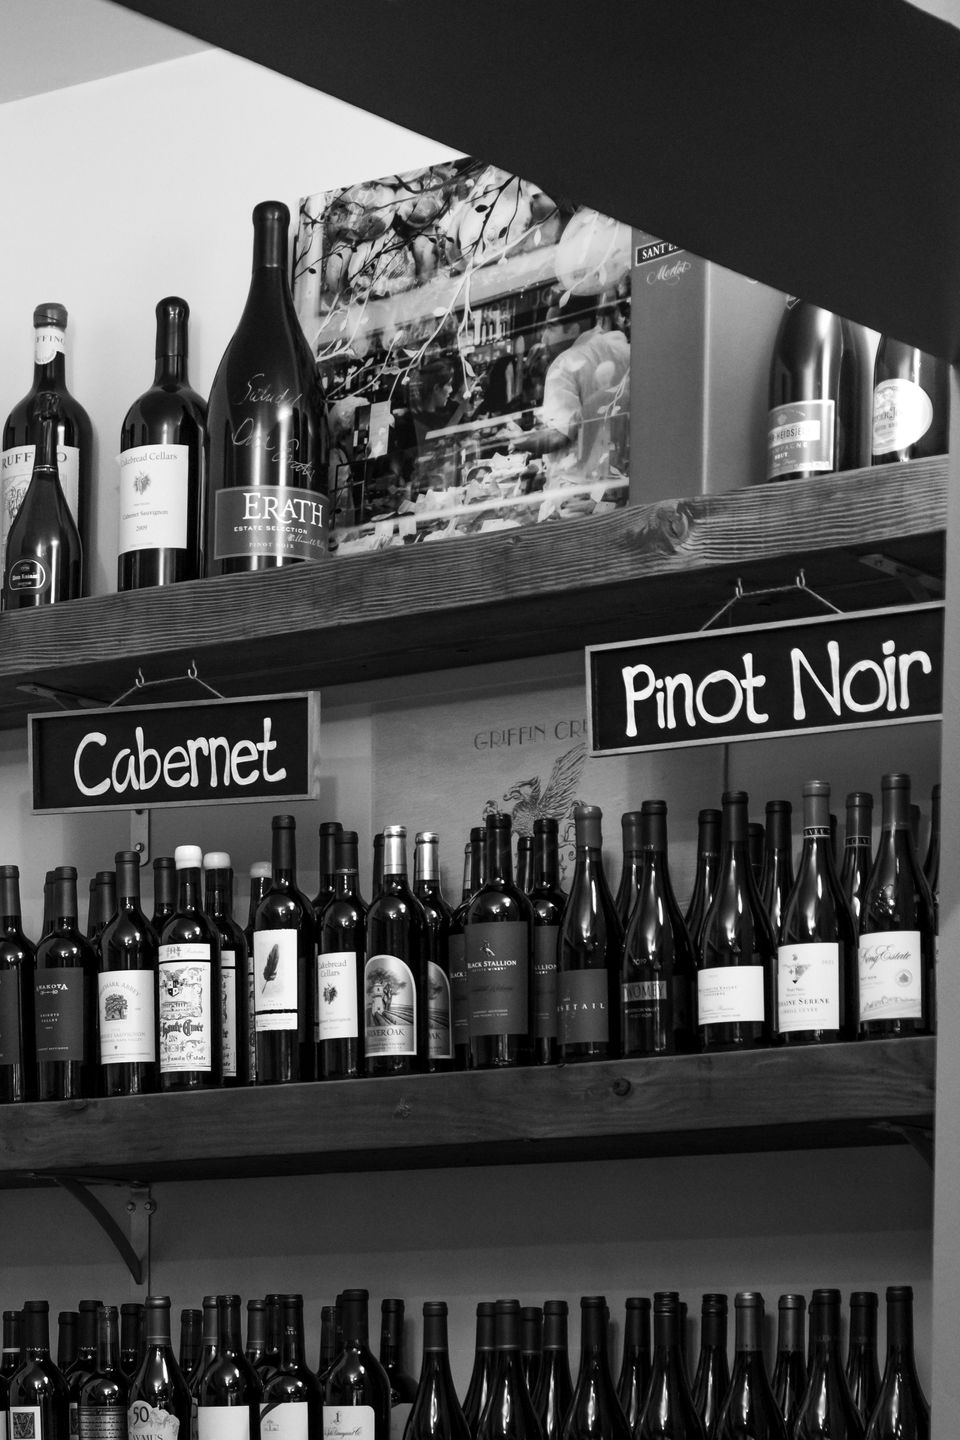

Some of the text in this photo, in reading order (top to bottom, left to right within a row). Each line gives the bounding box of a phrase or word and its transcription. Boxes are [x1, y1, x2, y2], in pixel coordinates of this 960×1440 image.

[646, 260, 692, 286] Merlot
[0, 451, 68, 471] RUFFO
[148, 451, 178, 462] Cellars
[242, 492, 324, 528] ERATH
[233, 525, 308, 535] ESTATE SELECTION
[621, 640, 932, 738] Pinot Noir
[473, 722, 546, 751] GRIFFIN
[73, 717, 287, 797] Cabernet
[878, 944, 912, 961] Estate
[483, 959, 517, 968] STALLION
[798, 996, 830, 1006] SERENE
[132, 1406, 150, 1426] 50
